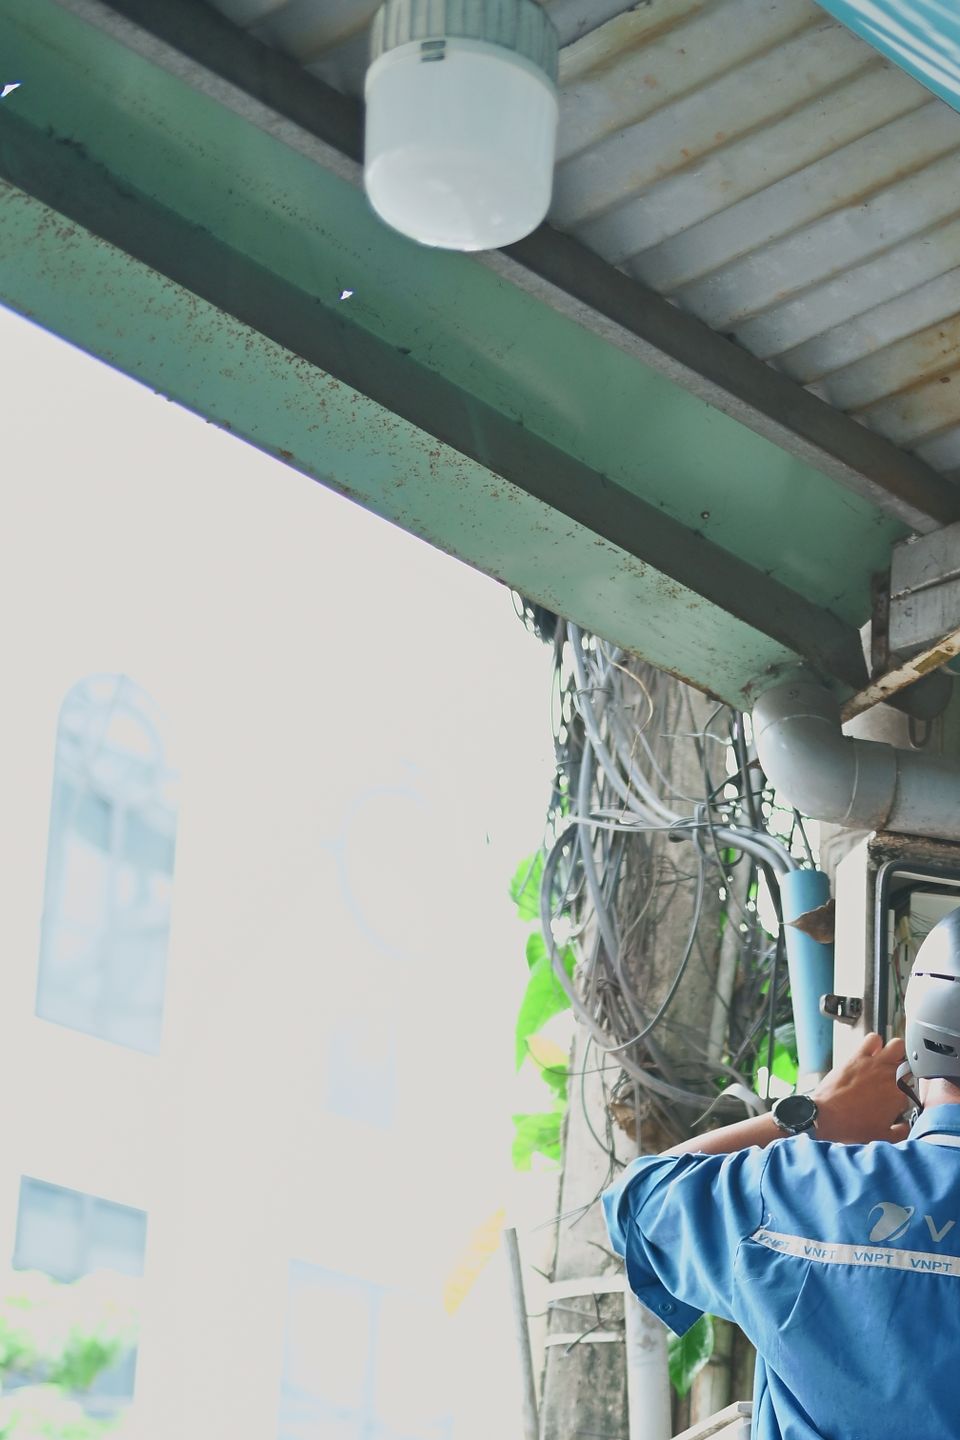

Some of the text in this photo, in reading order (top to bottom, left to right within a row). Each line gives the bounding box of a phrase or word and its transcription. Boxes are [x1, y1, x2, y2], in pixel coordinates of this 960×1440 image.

[804, 1245, 836, 1260] VNPT
[854, 1251, 894, 1265] VNPT
[910, 1258, 953, 1273] VNPT
